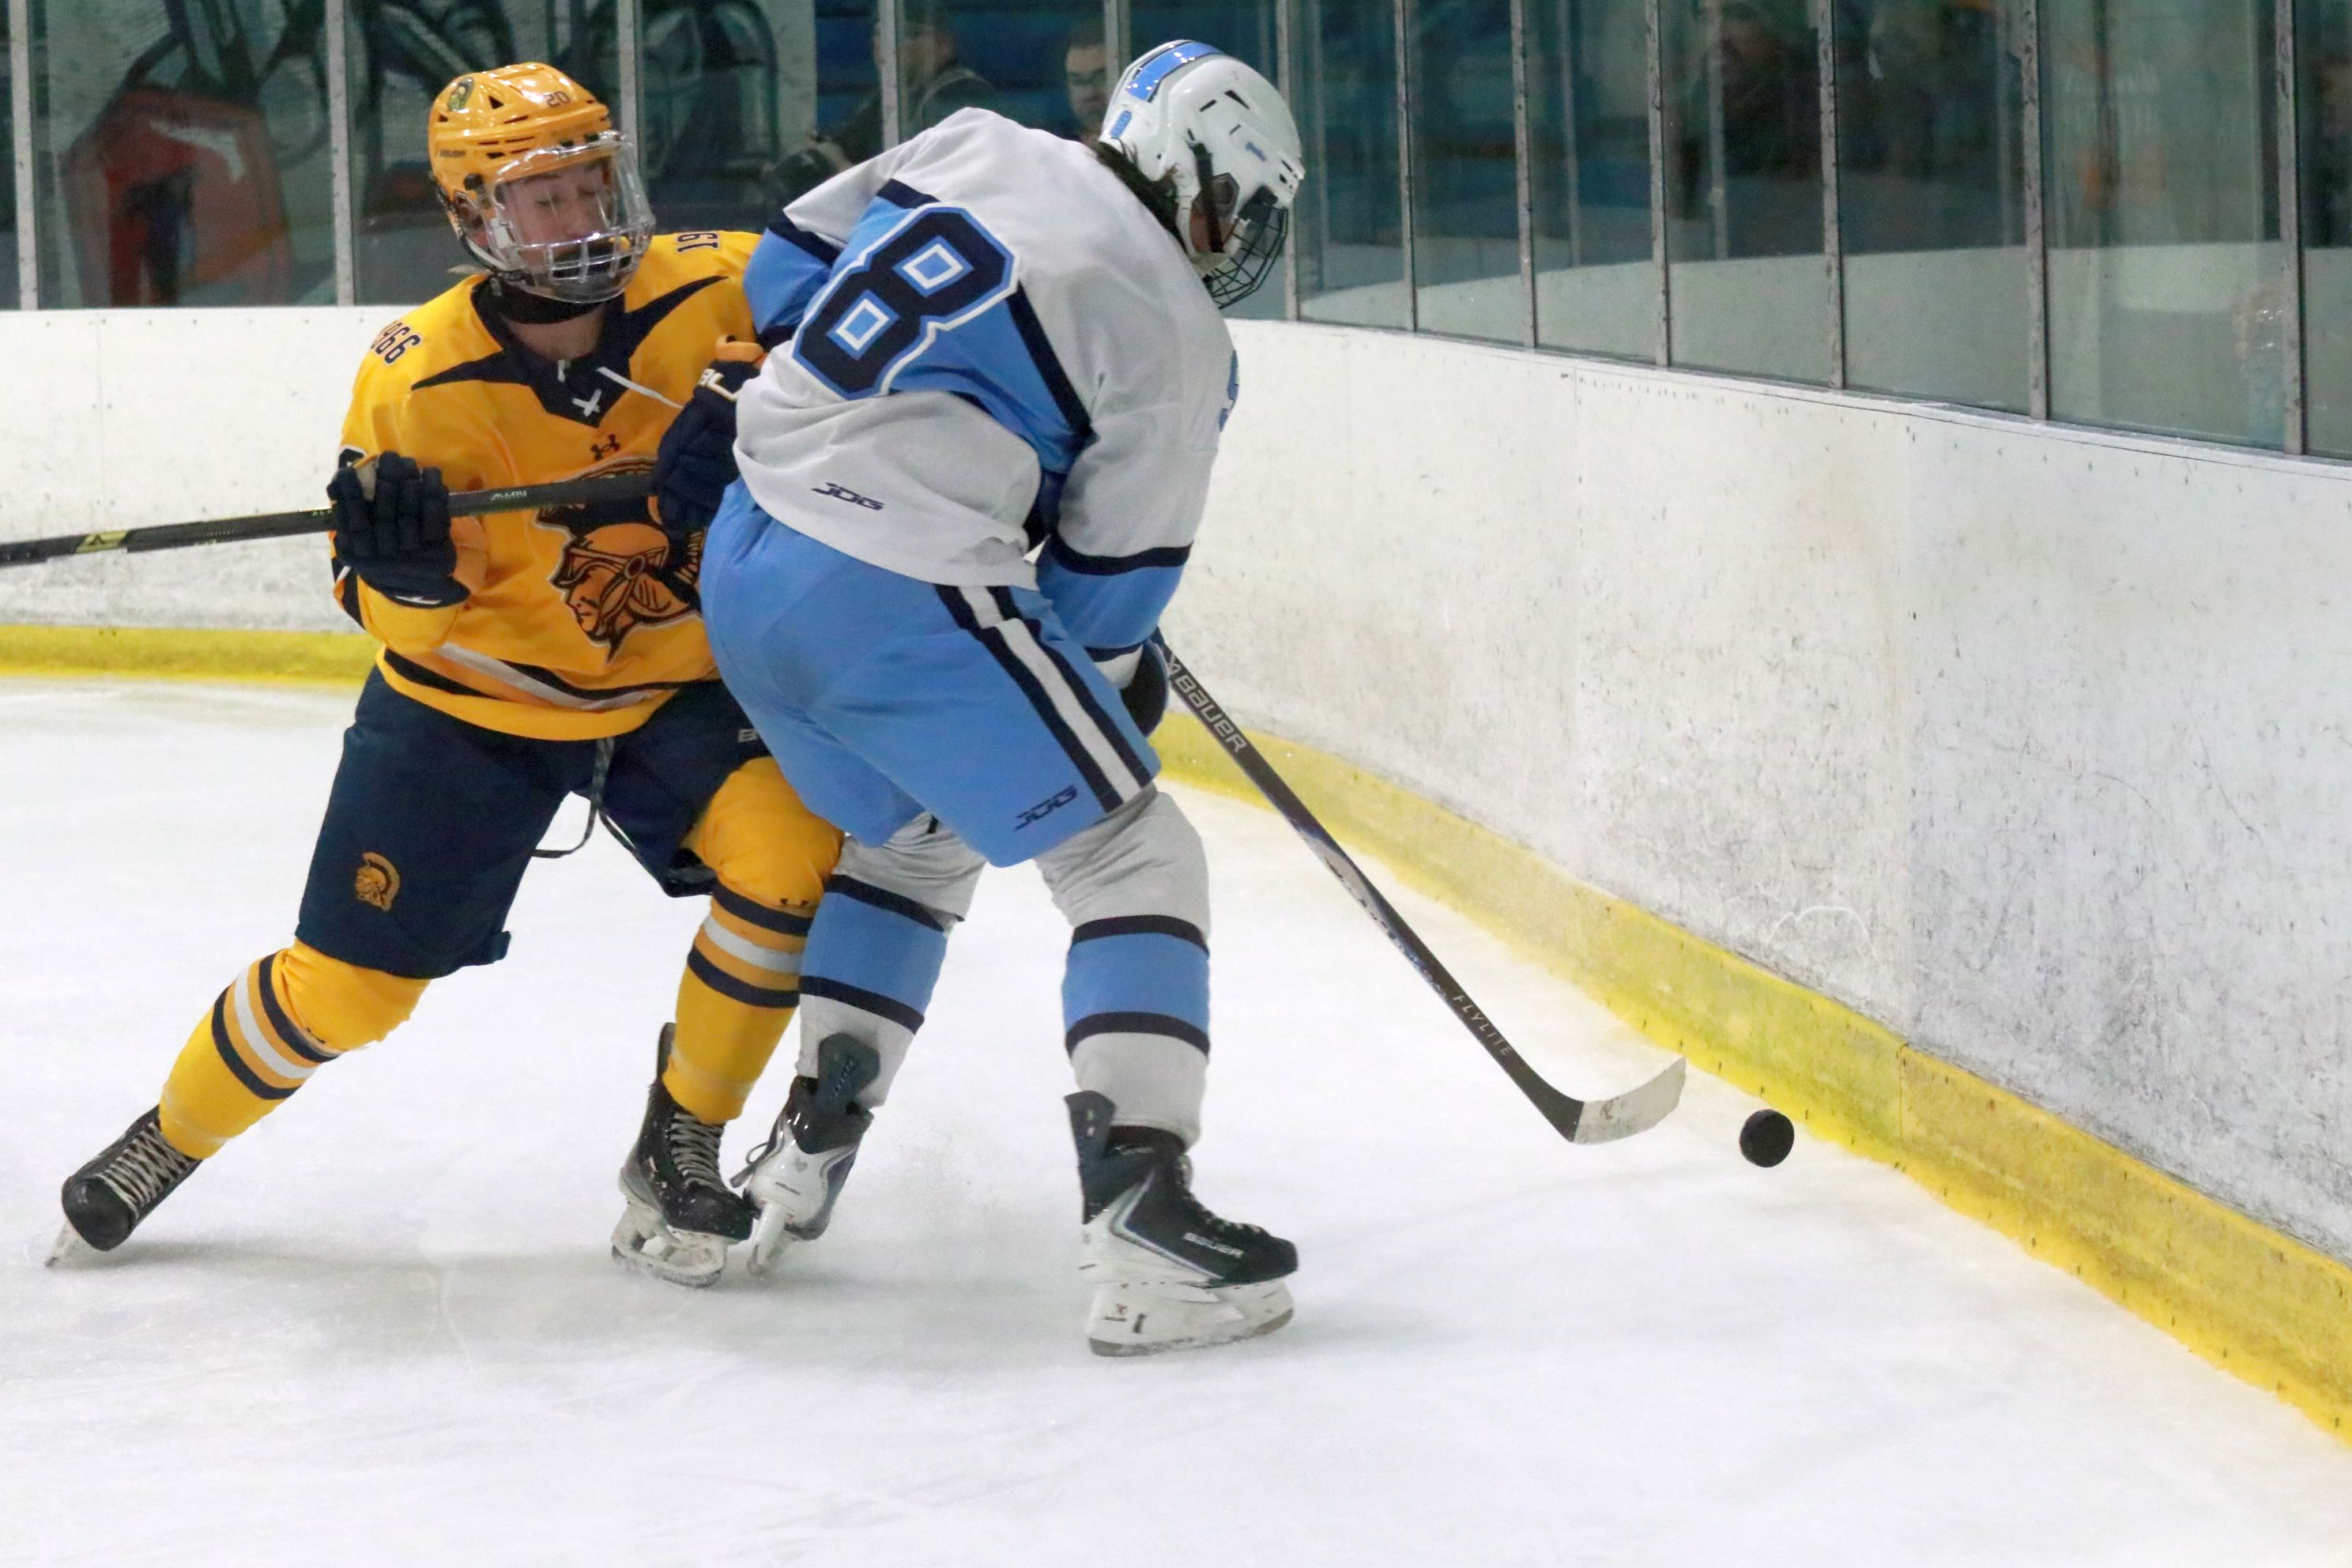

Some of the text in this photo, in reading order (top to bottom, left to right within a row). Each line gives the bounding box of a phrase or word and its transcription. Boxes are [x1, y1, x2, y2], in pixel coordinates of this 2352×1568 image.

[543, 91, 571, 107] 20
[791, 202, 1020, 401] 8
[370, 319, 421, 364] 966
[811, 481, 884, 511] JOG
[1013, 784, 1077, 832] JOG
[1453, 995, 1513, 1055] FLYLITE
